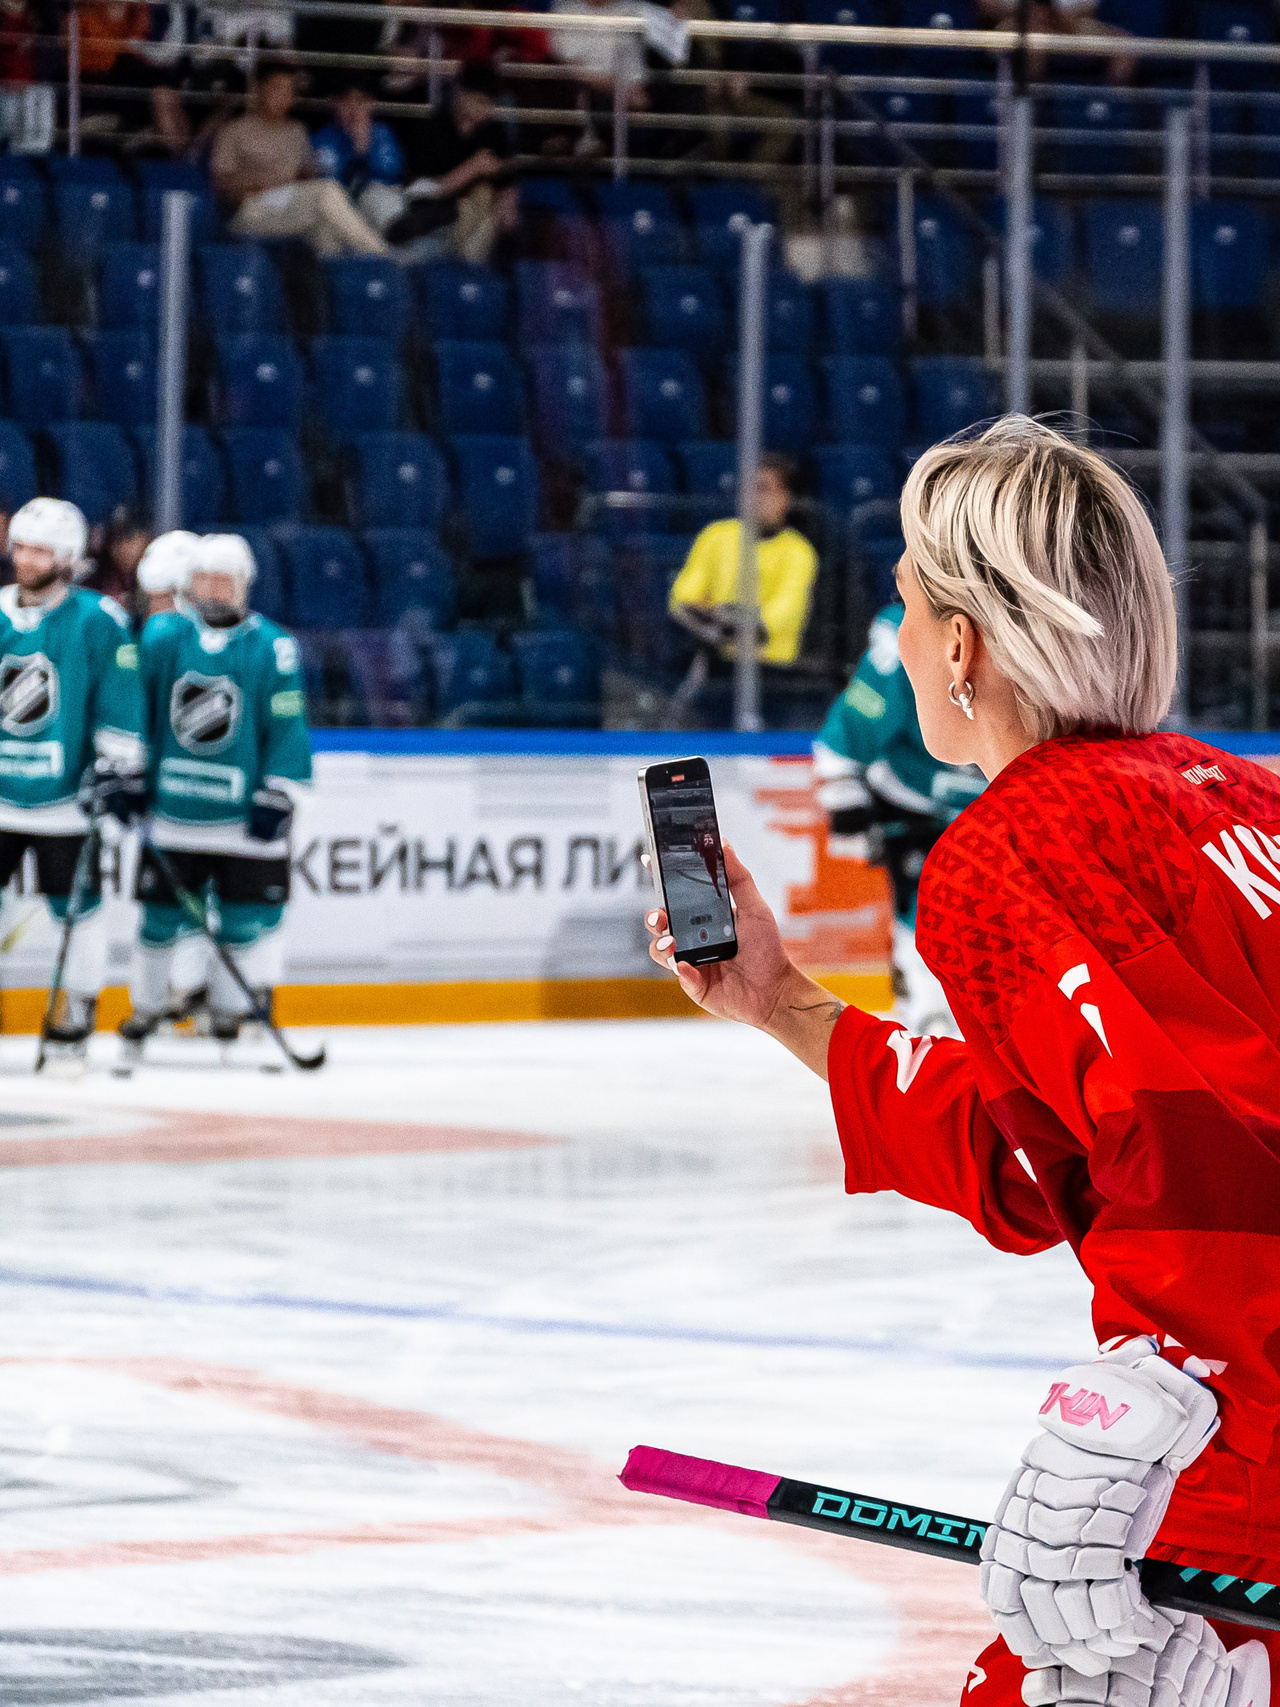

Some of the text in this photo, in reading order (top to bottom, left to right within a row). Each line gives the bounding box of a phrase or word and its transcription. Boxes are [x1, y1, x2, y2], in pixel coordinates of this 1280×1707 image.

[291, 822, 645, 893] КЕЙНАЯ ЛИ
[812, 1491, 987, 1547] DOMIN
